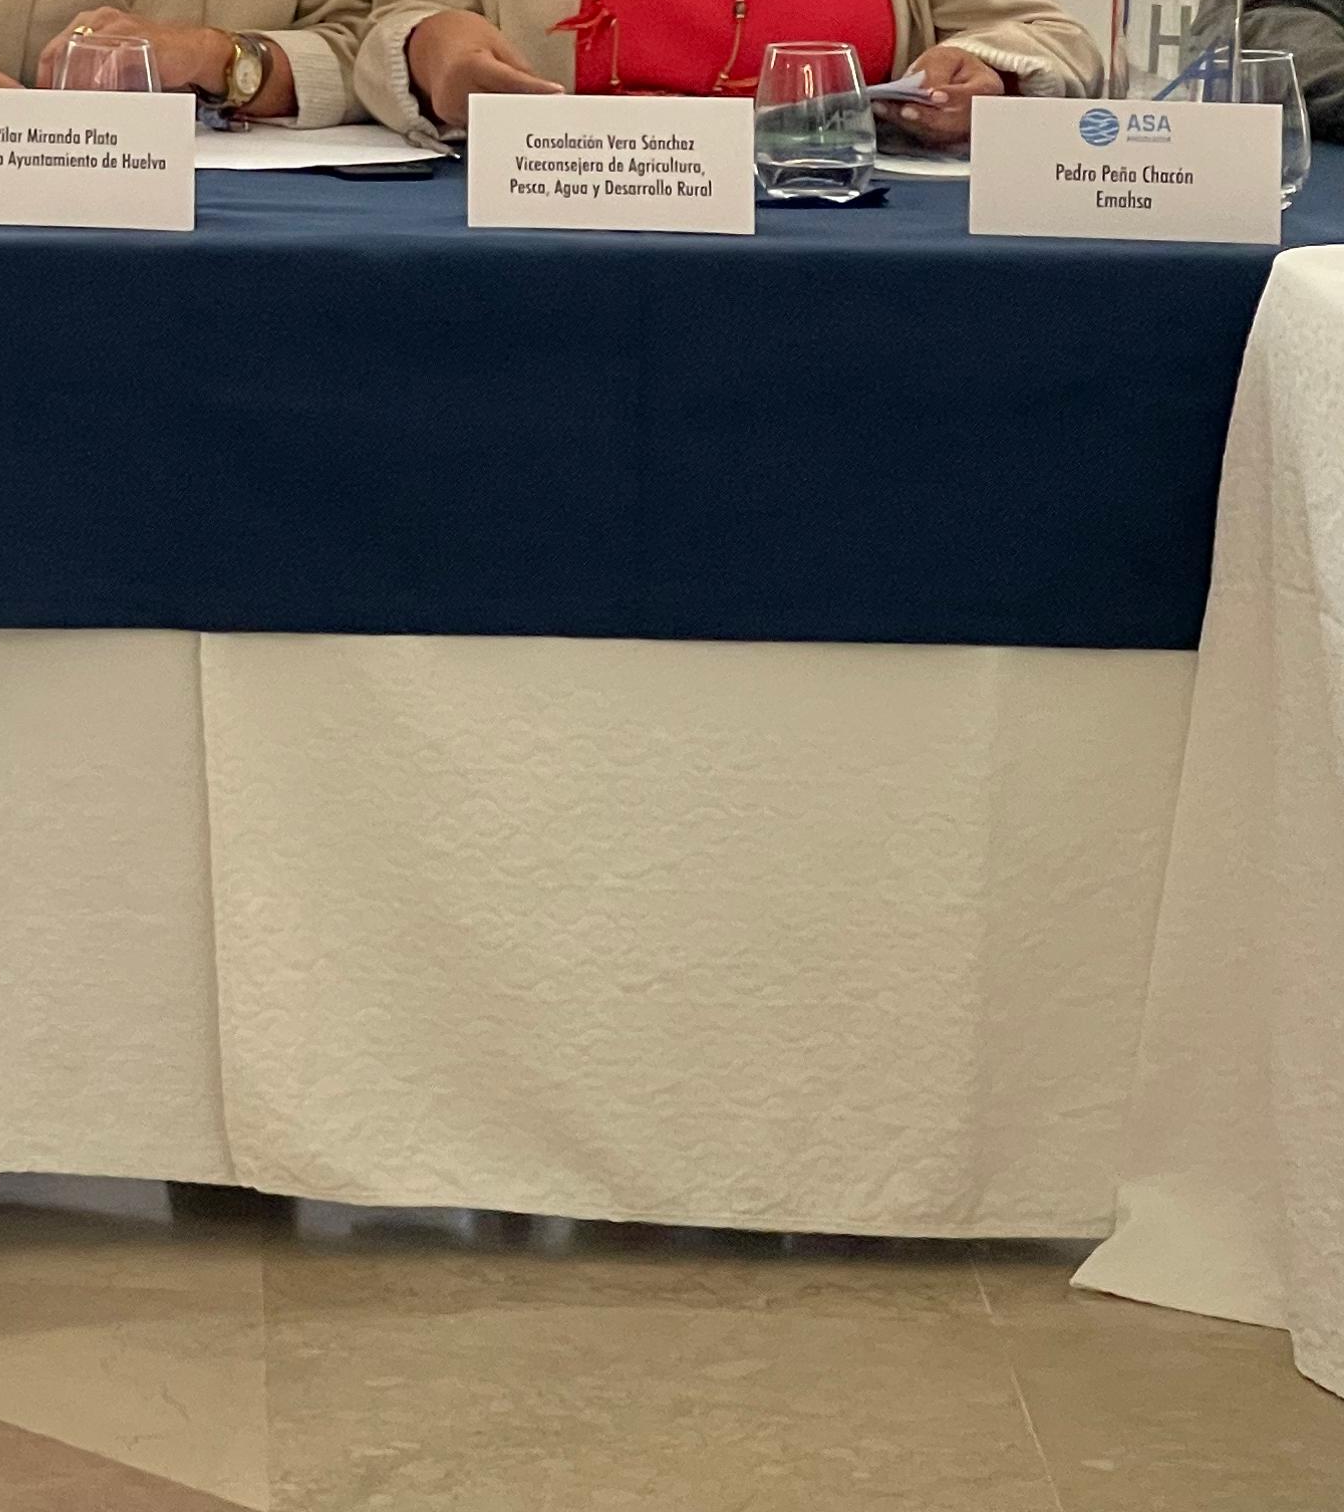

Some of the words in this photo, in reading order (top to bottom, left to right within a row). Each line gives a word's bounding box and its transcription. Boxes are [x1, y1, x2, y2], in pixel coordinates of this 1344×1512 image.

[1126, 114, 1171, 133] ASA
[27, 128, 80, 145] Miranda
[85, 130, 118, 145] Plata
[526, 134, 603, 151] Consolación
[607, 135, 636, 151] Vera
[642, 134, 694, 152] Sánchez
[8, 152, 98, 169] Ayuntamiento
[102, 154, 117, 168] de
[122, 154, 166, 170] Huelva
[516, 156, 603, 176] Viceconsejera
[608, 157, 624, 173] de
[1055, 164, 1096, 182] Pedro
[1102, 165, 1137, 183] Peña
[1142, 166, 1194, 184] Chacón
[510, 178, 550, 196] Pesca,
[554, 180, 588, 198] Agua
[592, 184, 600, 199] y
[605, 180, 672, 196] Desarrollo
[677, 180, 712, 197] Rural
[1096, 191, 1152, 209] Emahsa
